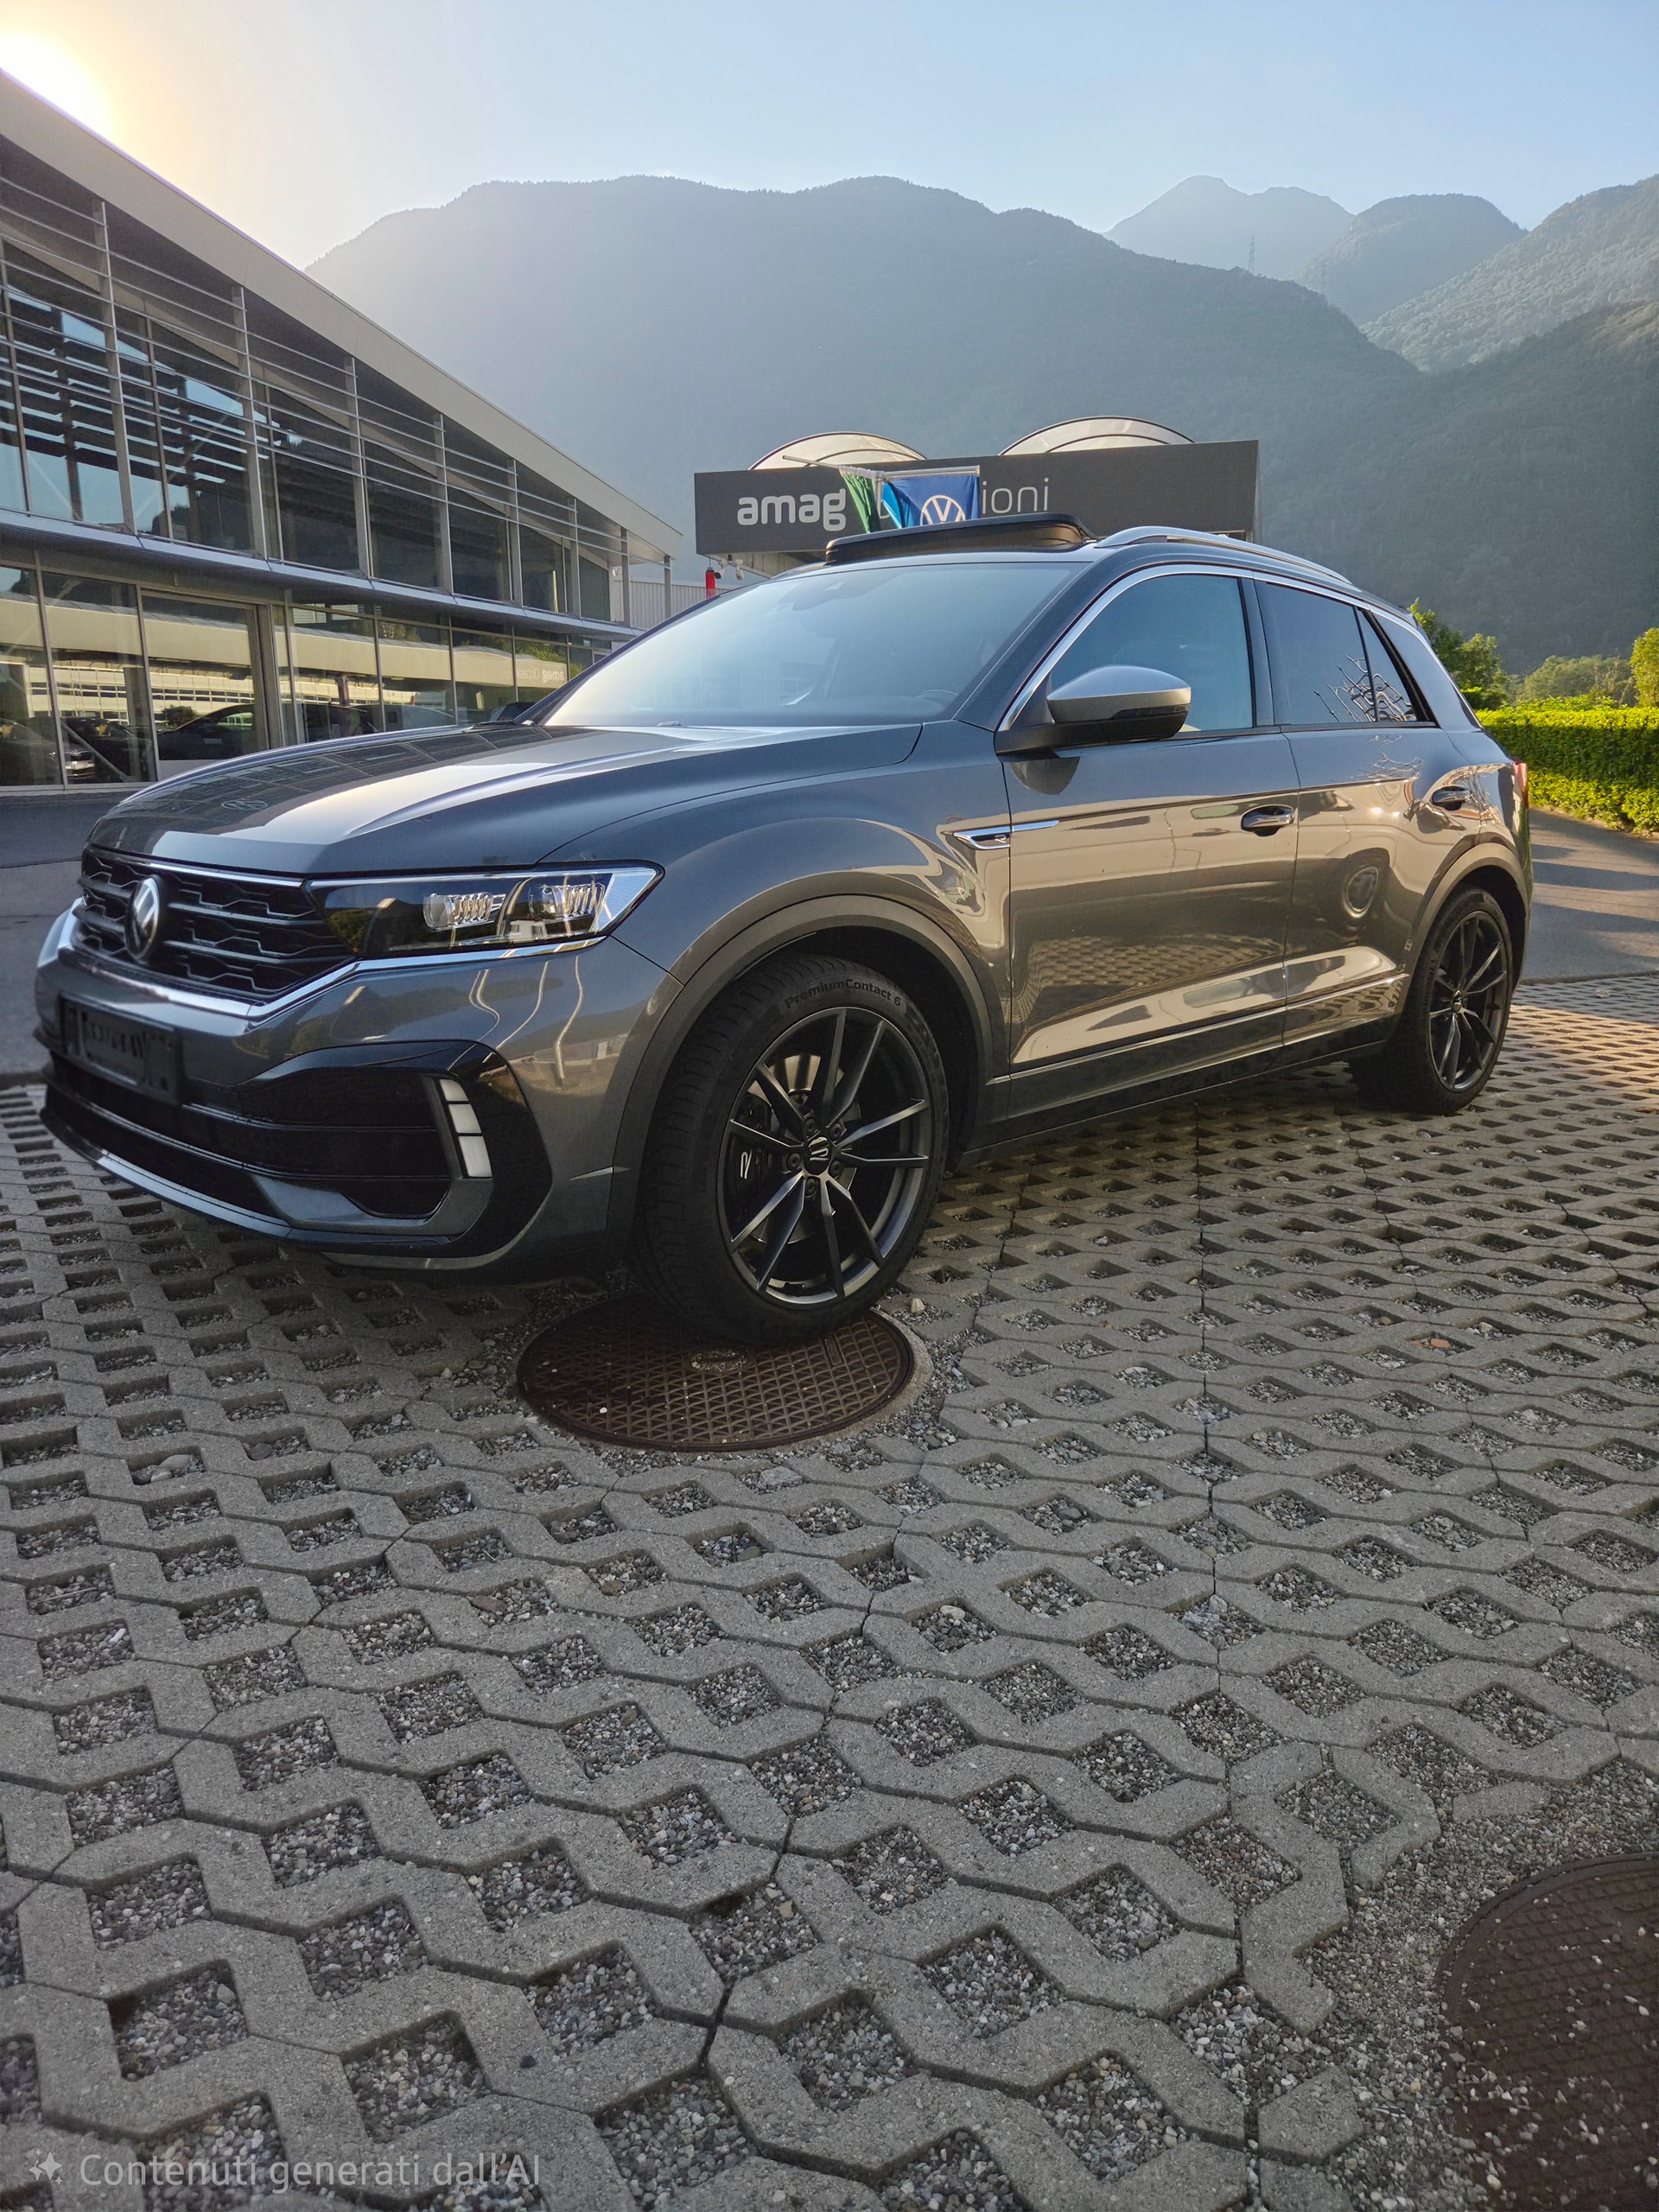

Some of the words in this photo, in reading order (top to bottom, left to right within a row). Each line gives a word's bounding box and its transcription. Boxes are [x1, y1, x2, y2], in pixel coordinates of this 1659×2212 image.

[737, 488, 846, 531] amag
[785, 978, 893, 1008] PremiumContact
[893, 996, 902, 1007] 6
